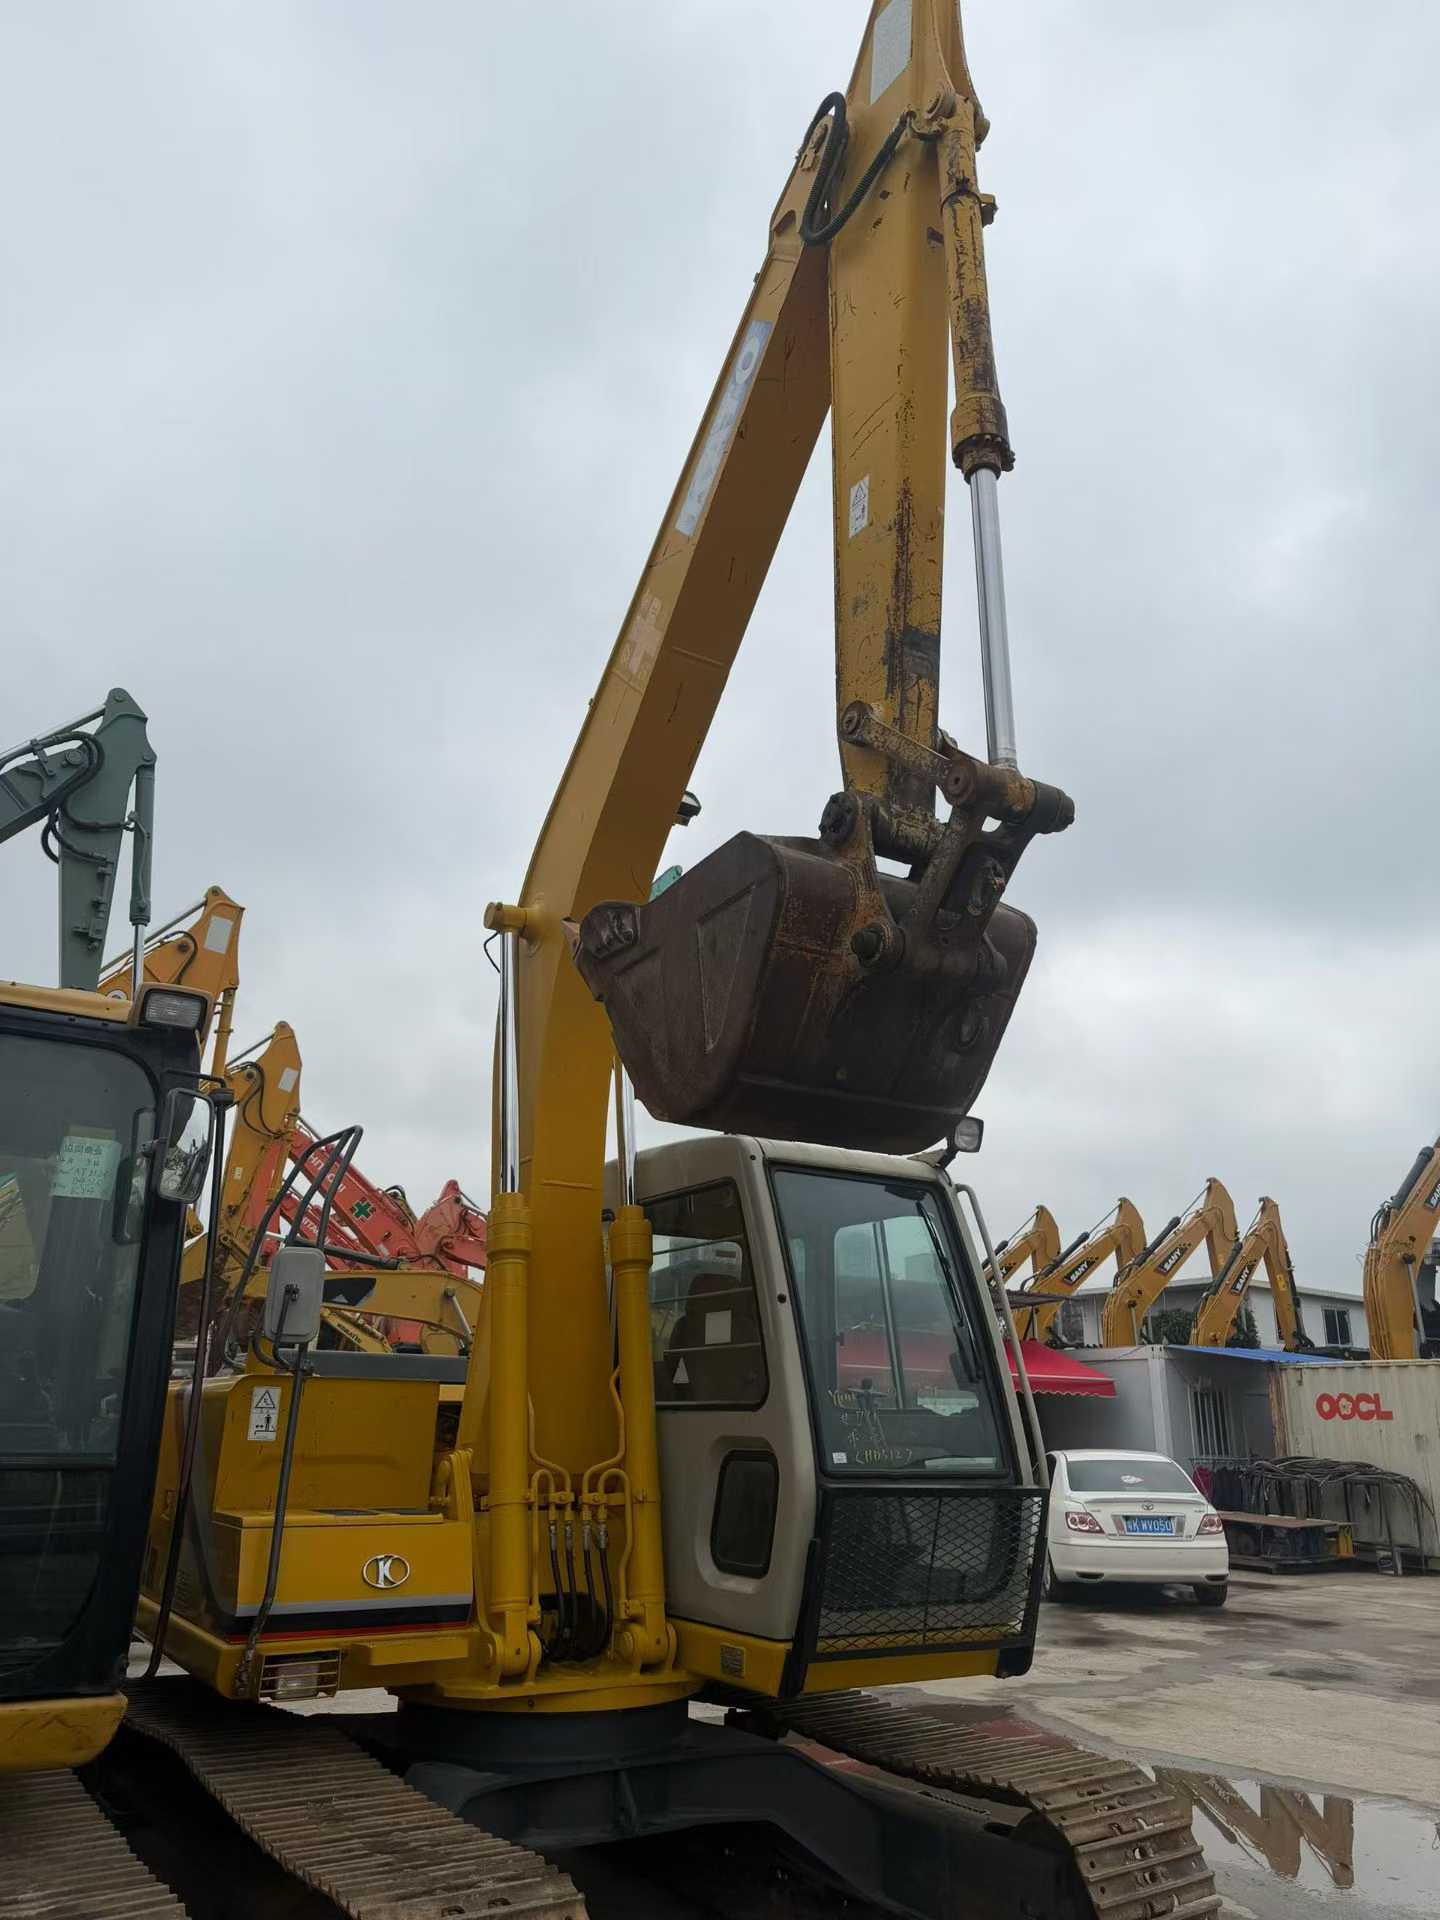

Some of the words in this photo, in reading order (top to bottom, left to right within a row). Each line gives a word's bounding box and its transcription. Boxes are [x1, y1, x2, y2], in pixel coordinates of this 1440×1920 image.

[1070, 1260, 1089, 1281] SANY
[1164, 1247, 1182, 1271] SANY
[1235, 1265, 1250, 1293] SANY
[1315, 1392, 1394, 1421] OOCL
